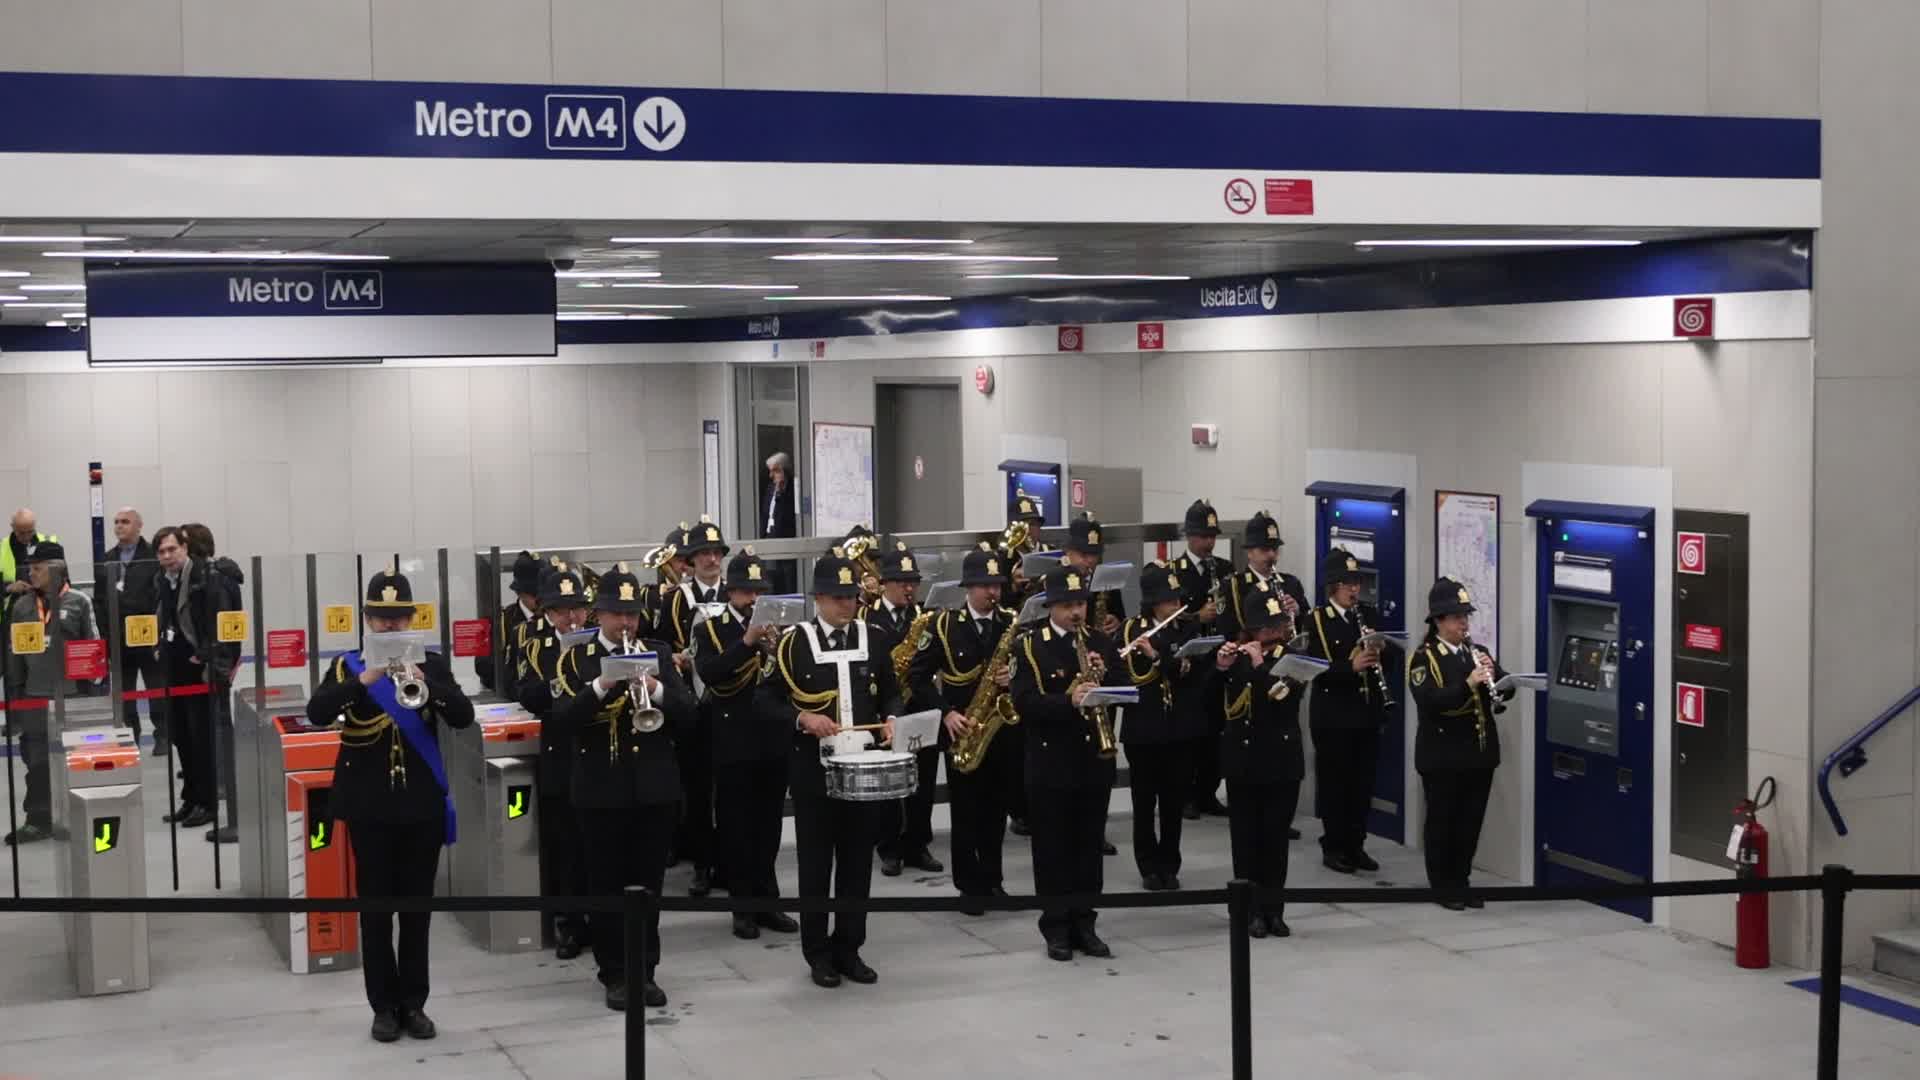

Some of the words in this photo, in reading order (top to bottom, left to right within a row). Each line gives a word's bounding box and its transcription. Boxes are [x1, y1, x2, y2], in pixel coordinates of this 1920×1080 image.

[415, 100, 532, 138] Metro
[554, 107, 618, 138] M4
[228, 277, 314, 303] Metro
[330, 279, 377, 301] M4
[1200, 287, 1236, 307] Uscita
[1237, 285, 1259, 306] Exit
